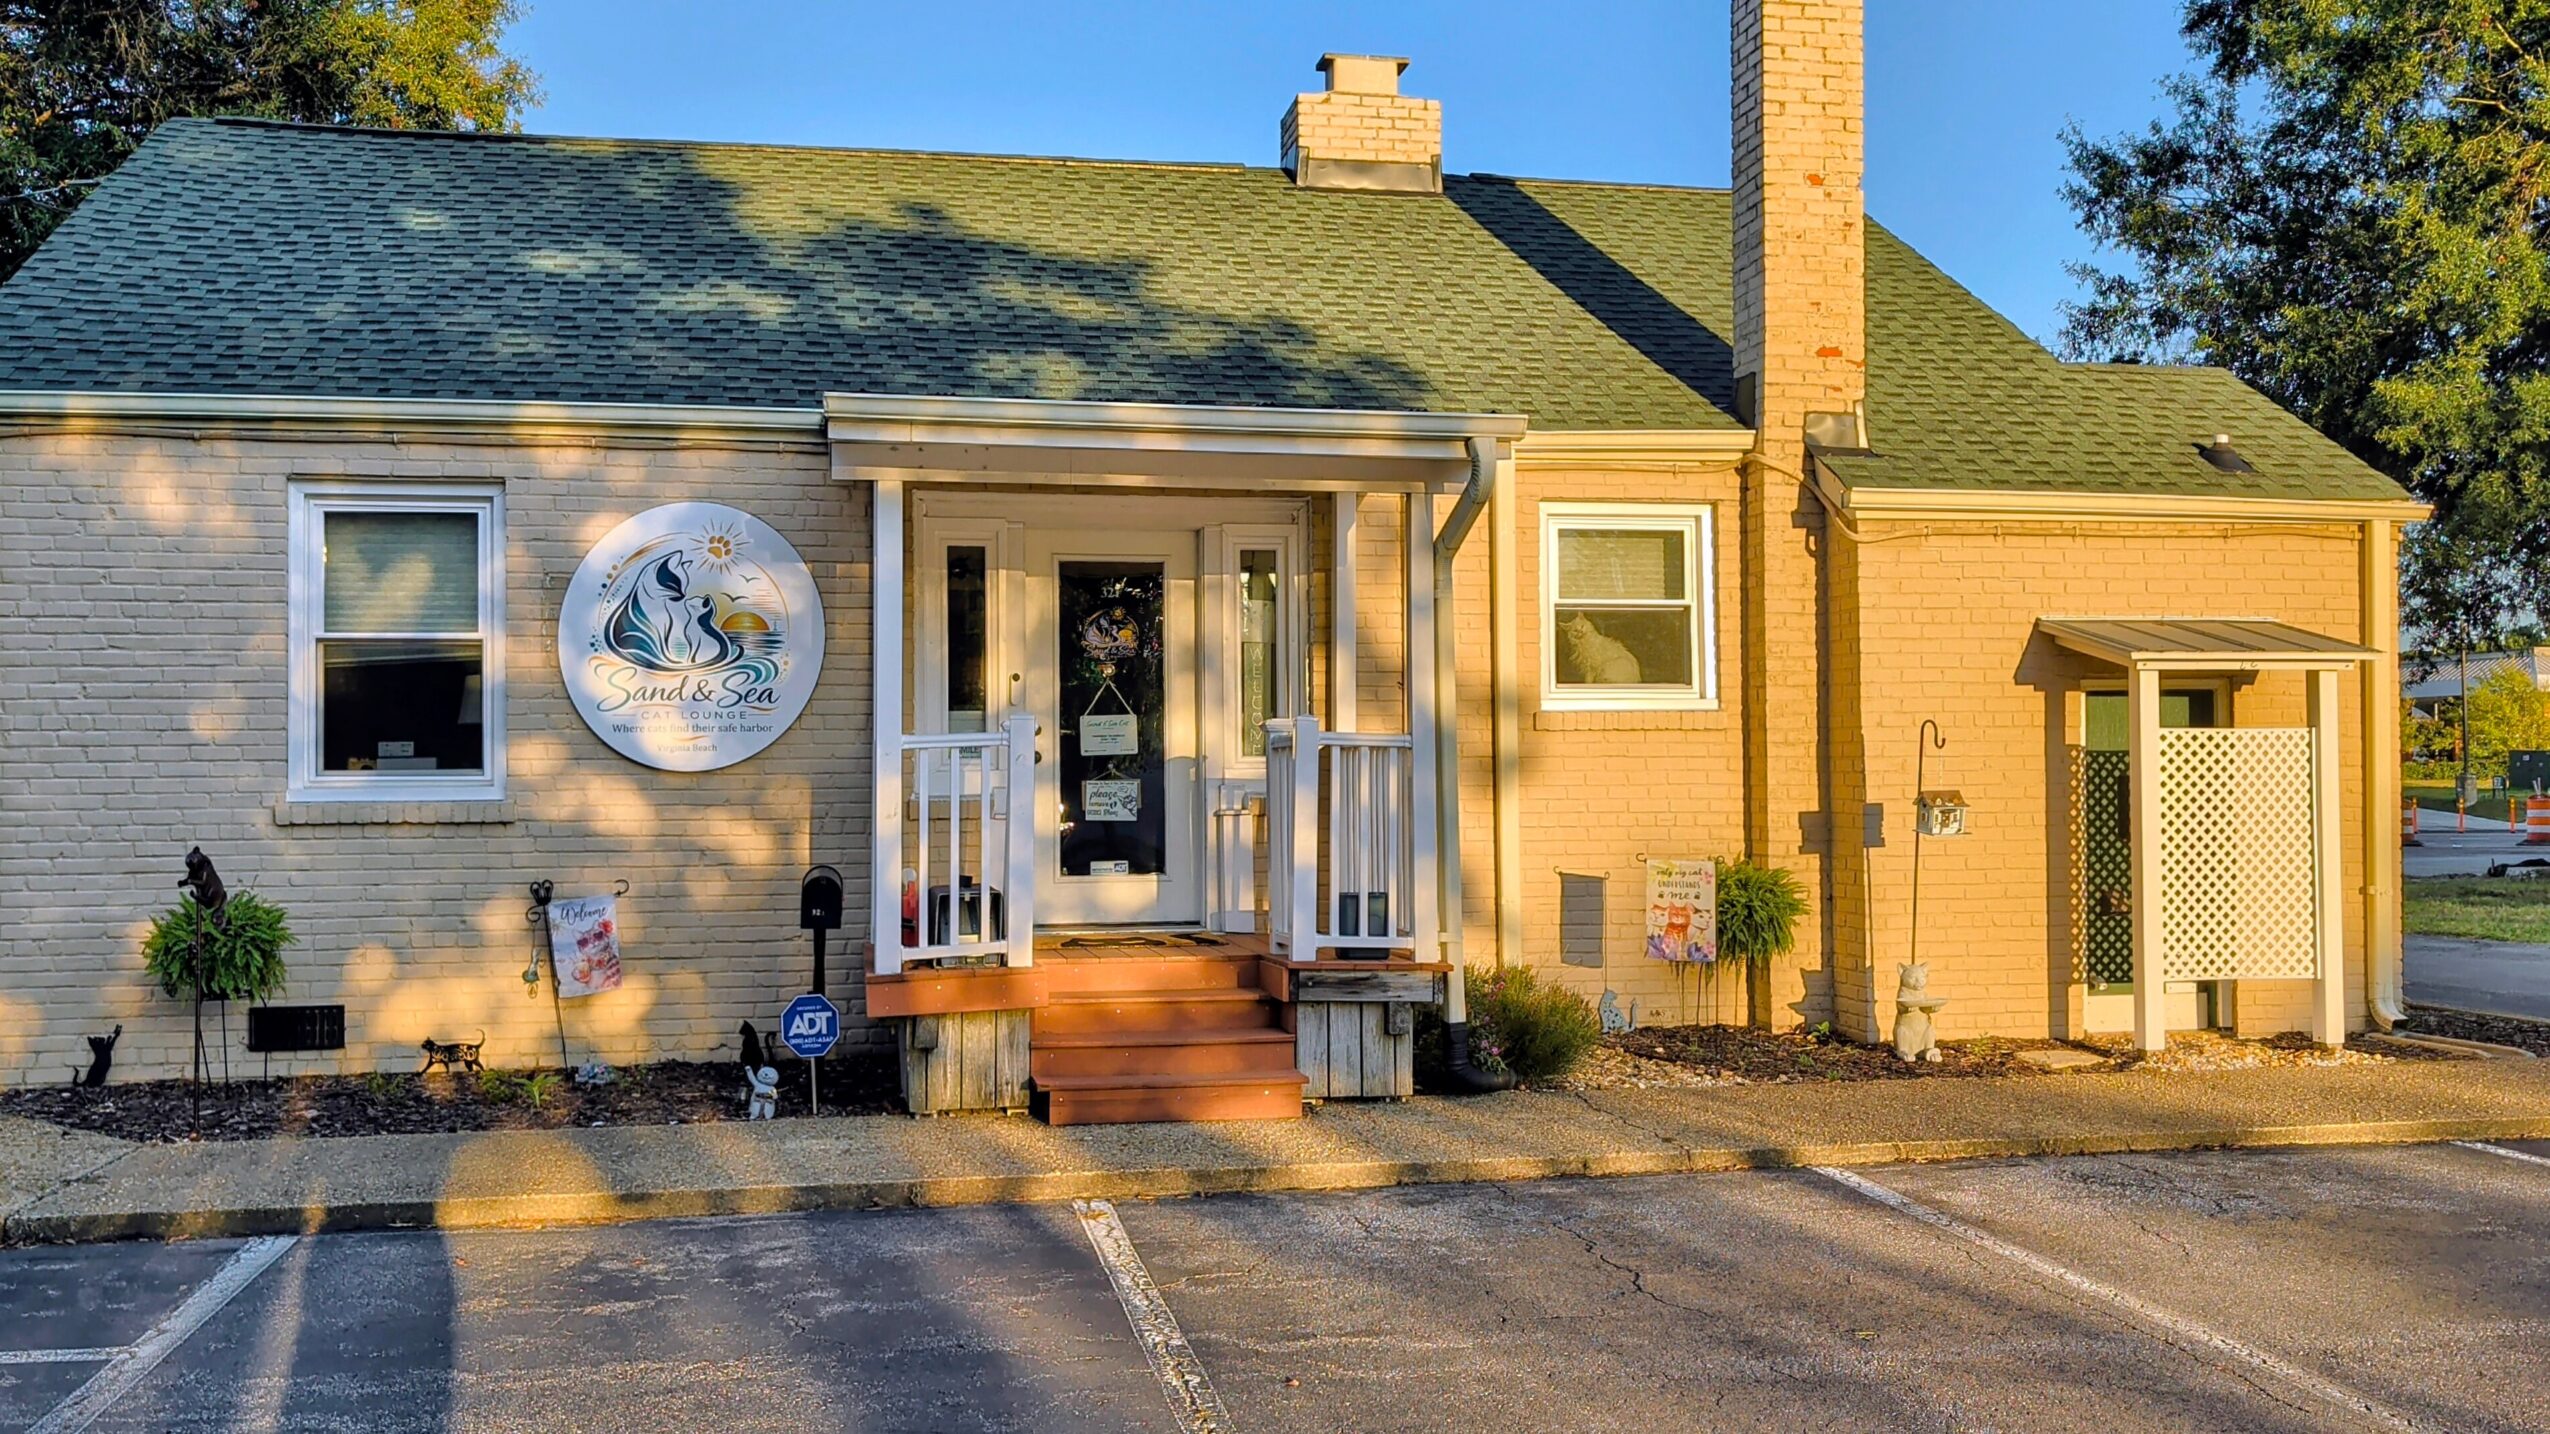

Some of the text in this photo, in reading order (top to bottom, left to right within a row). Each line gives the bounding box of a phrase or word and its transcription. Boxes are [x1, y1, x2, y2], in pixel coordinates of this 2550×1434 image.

[594, 664, 781, 712] Sand & Sea
[1250, 647, 1264, 755] WELCOME
[641, 711, 748, 720] CAT LOUNGE
[612, 723, 774, 733] Where cats find their safe harbor
[657, 744, 718, 754] Virginia Beach
[1688, 867, 1703, 876] cat
[1667, 891, 1690, 900] me
[561, 902, 609, 926] Welcome
[788, 1011, 833, 1037] ADT
